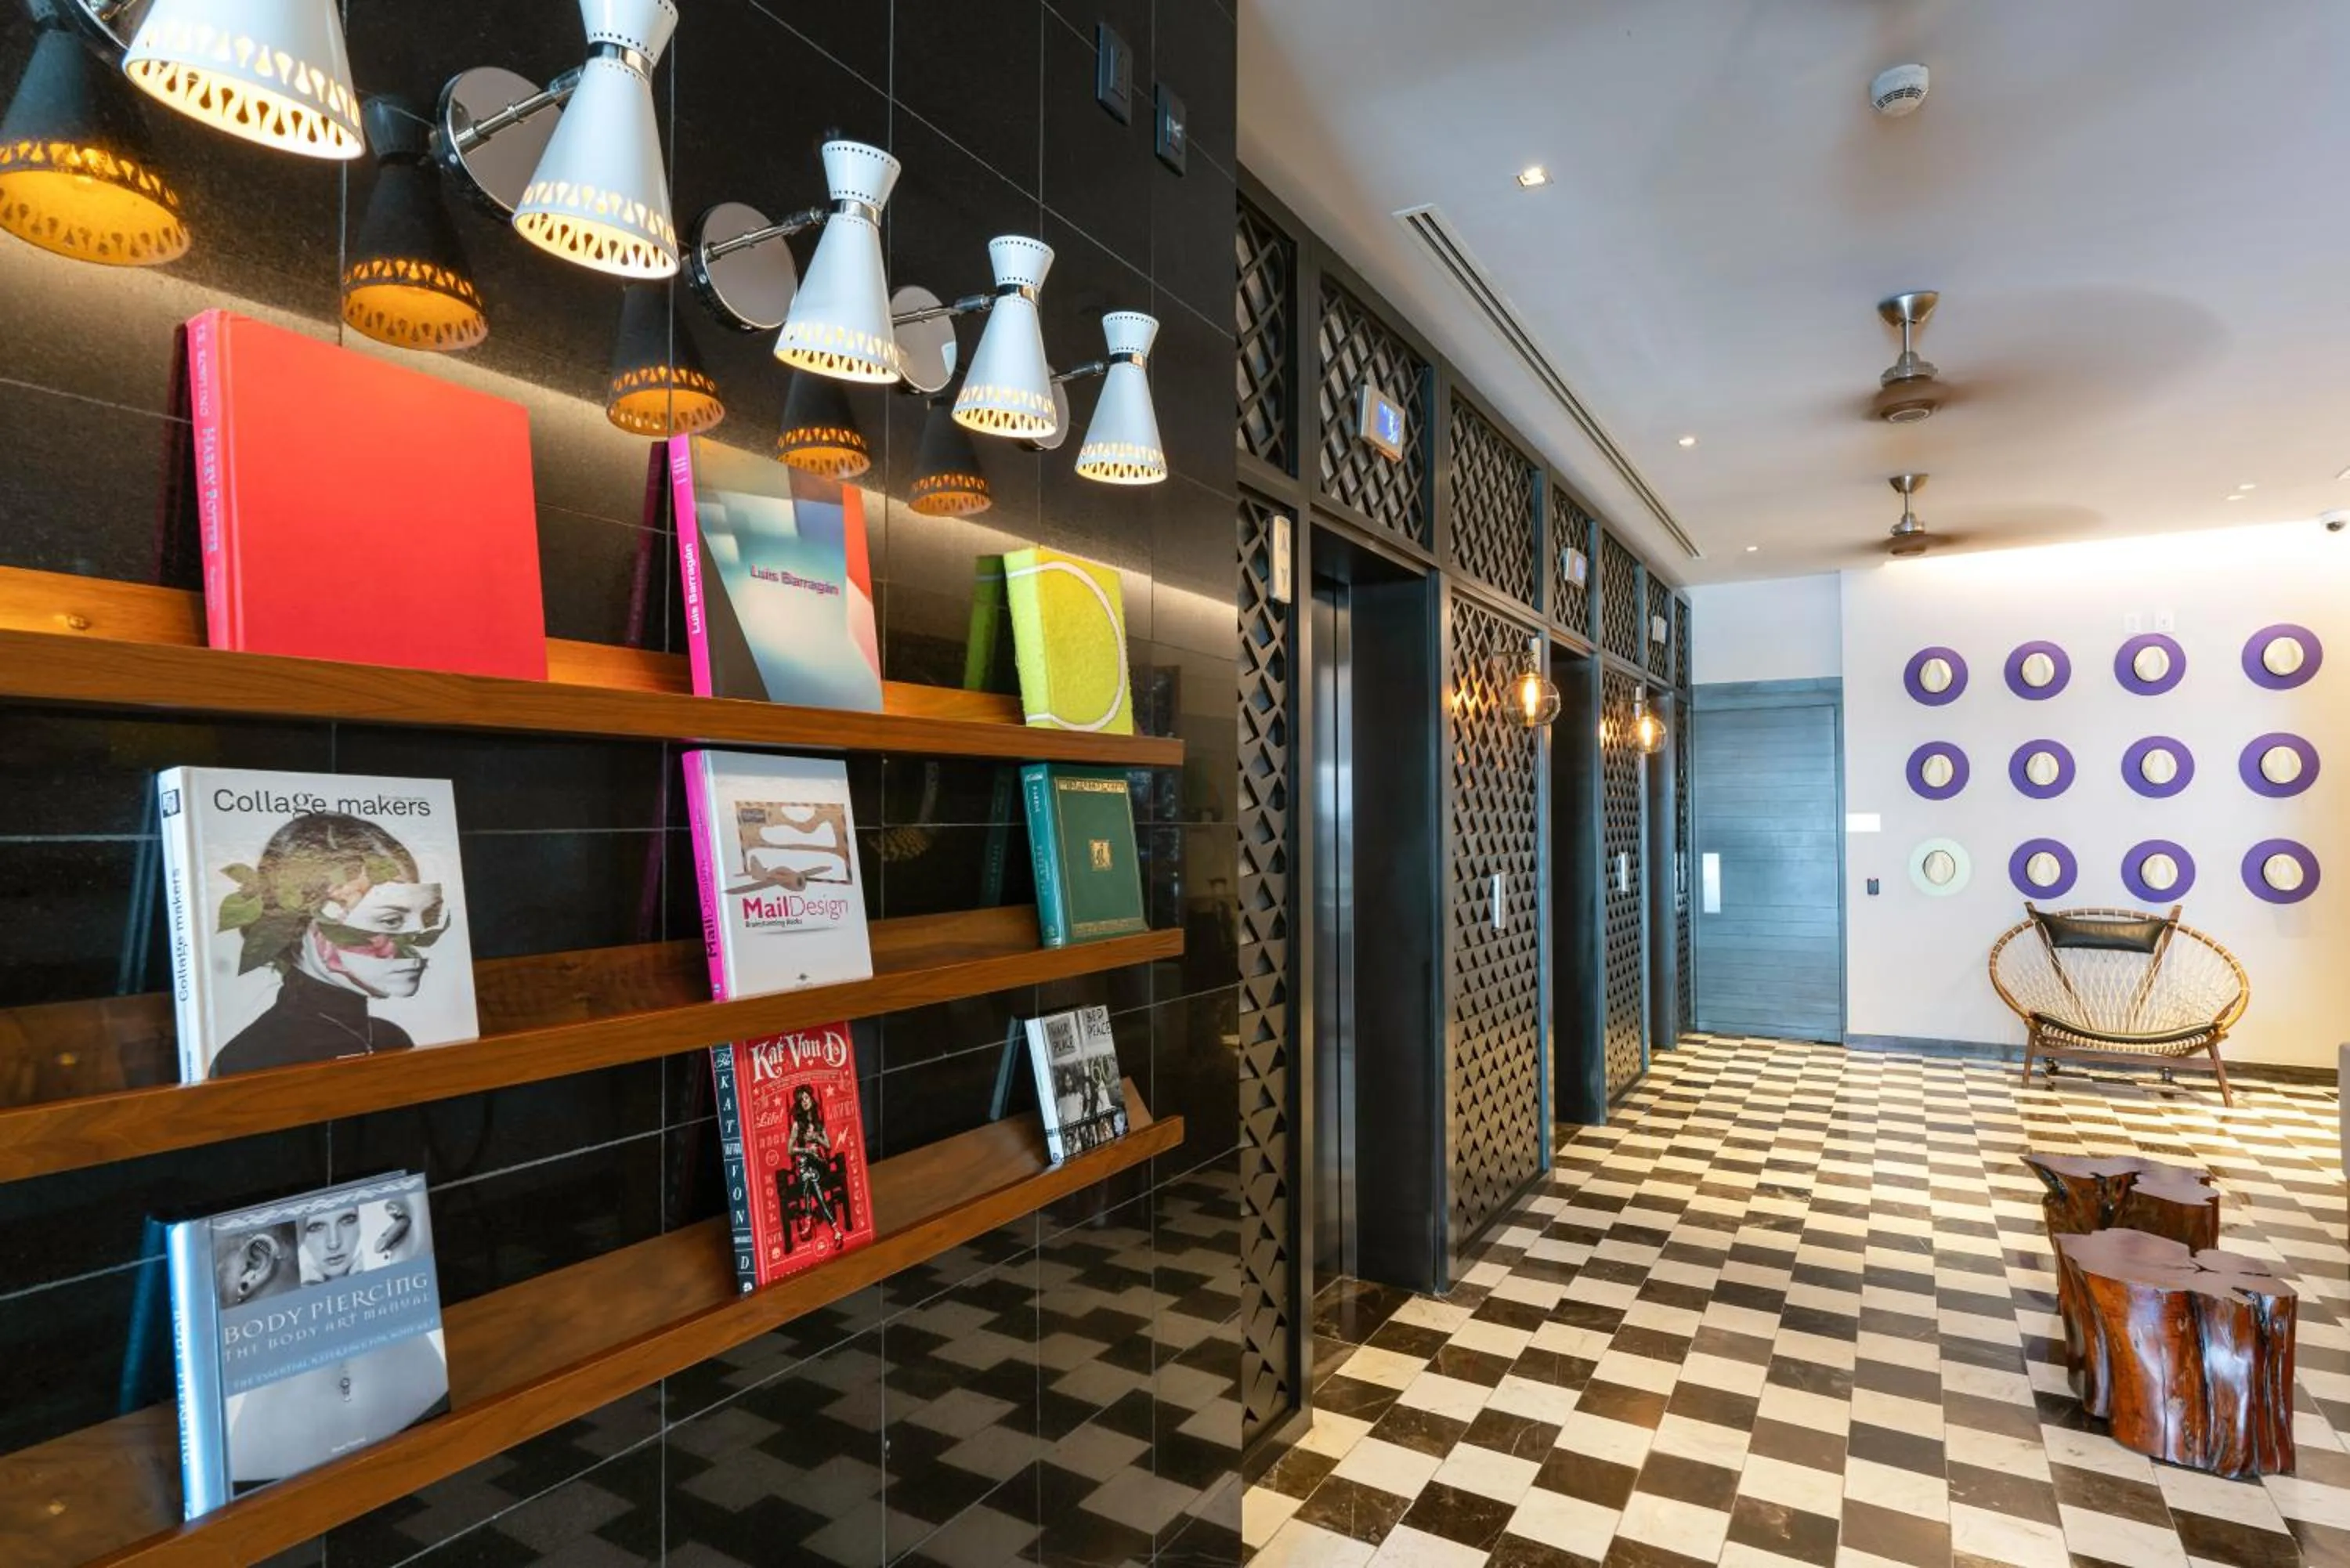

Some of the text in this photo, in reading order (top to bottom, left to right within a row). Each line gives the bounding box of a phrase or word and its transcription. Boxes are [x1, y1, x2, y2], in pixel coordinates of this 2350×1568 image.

[203, 428, 215, 486] HARRY
[206, 488, 218, 552] POTTER
[750, 563, 779, 581] Luis
[691, 605, 702, 634] Luis
[213, 788, 432, 820] Collage makers
[172, 868, 189, 1003] Collage makers
[750, 1036, 783, 1083] Kat
[785, 1032, 821, 1068] Von
[822, 1031, 847, 1068] D
[740, 1255, 750, 1270] D
[224, 1306, 302, 1345] BODY
[268, 1326, 316, 1349] BODY
[325, 1312, 356, 1331] ART
